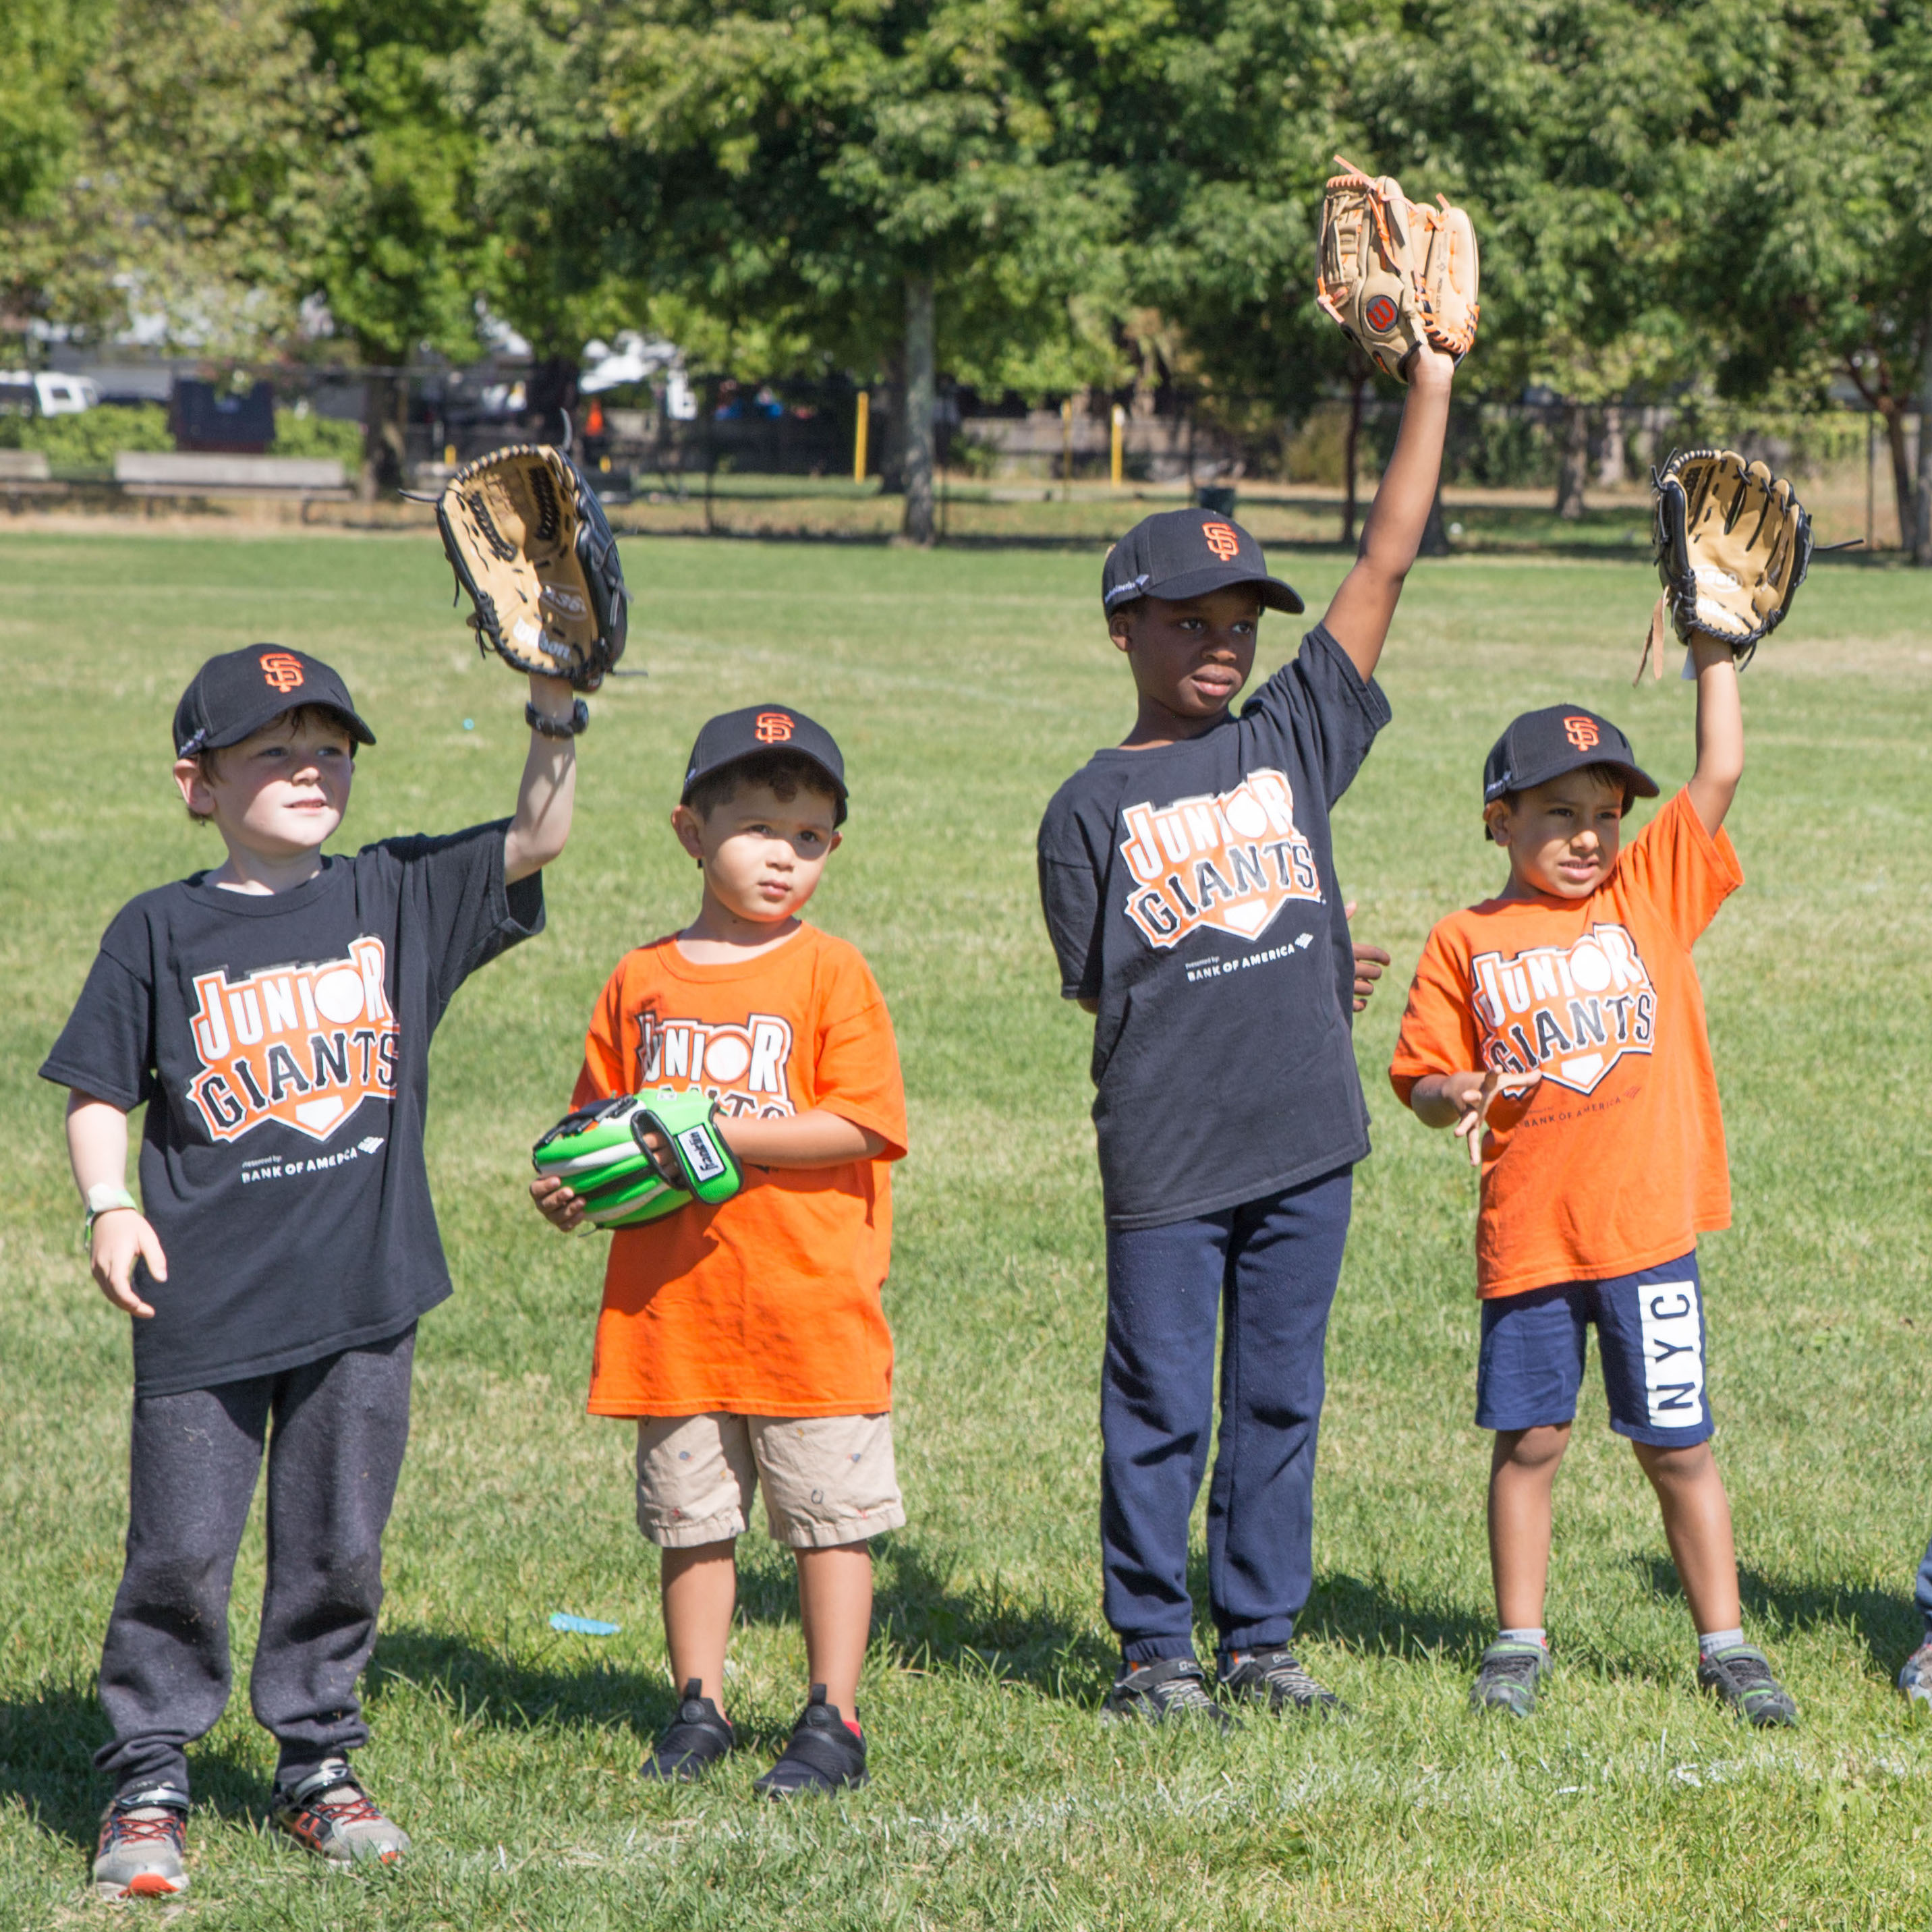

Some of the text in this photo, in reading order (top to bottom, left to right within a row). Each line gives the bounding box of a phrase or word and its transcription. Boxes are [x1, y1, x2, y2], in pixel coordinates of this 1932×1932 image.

[1202, 522, 1239, 561] SF
[259, 652, 304, 693] SF
[755, 712, 795, 743] SF
[1563, 716, 1599, 751] SF
[1130, 776, 1291, 879] JUNIOR
[1136, 841, 1316, 936] GIANTS
[1187, 943, 1295, 982] BANK OF AMERICA
[1479, 932, 1642, 1028] JUNIOR
[198, 946, 385, 1060] JUNIOR
[1488, 994, 1653, 1074] GIANTS
[200, 1029, 400, 1130] GIANTS
[1524, 1115, 1556, 1127] BANK
[1559, 1112, 1572, 1120] OF
[242, 1166, 282, 1183] BANK
[285, 1162, 304, 1175] OF
[1650, 1294, 1695, 1410] NYC
